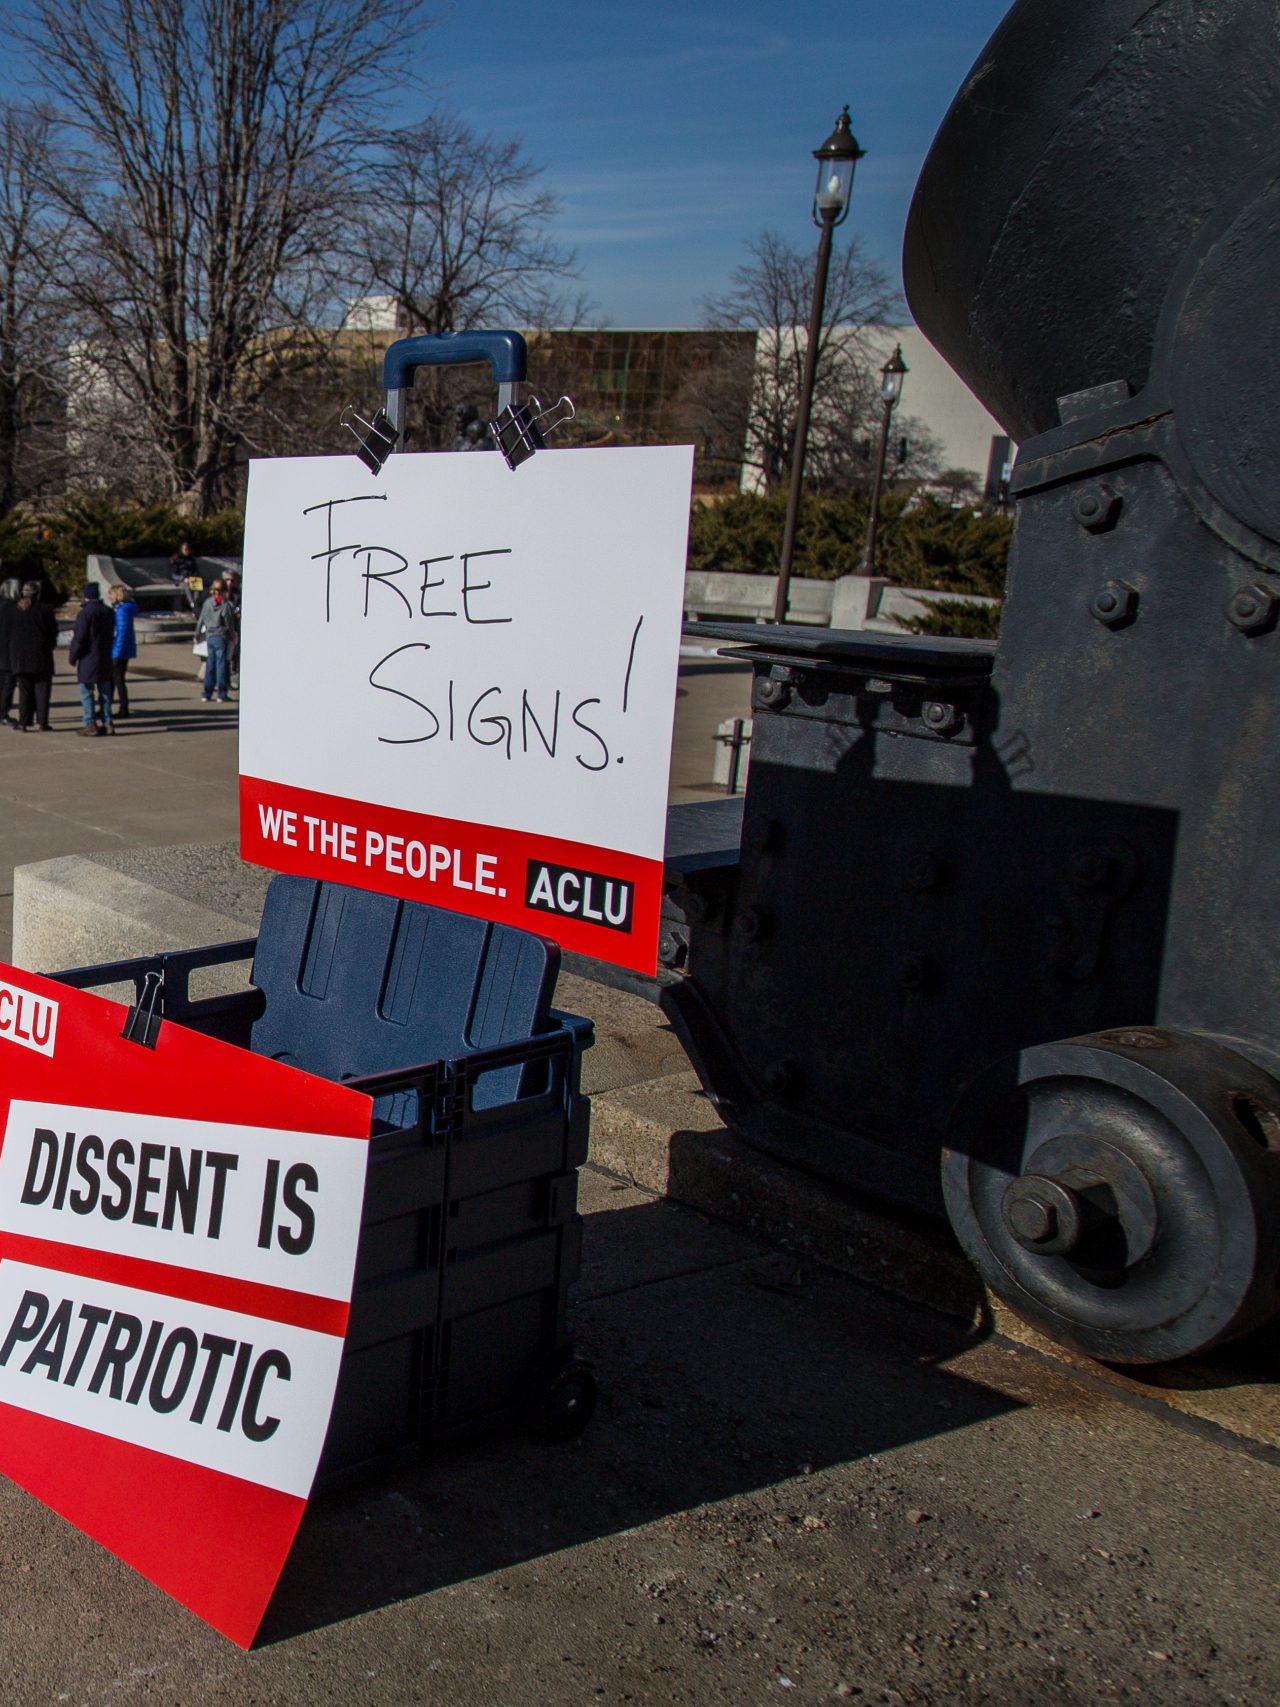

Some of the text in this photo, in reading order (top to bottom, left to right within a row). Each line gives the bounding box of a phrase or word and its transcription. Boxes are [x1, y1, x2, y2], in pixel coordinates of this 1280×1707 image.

[303, 494, 513, 623] FREE
[369, 615, 644, 771] SIGNS!
[258, 803, 508, 899] WE THE PEOPLE.
[529, 866, 630, 926] ACLU
[20, 1128, 319, 1256] DISSENT IS
